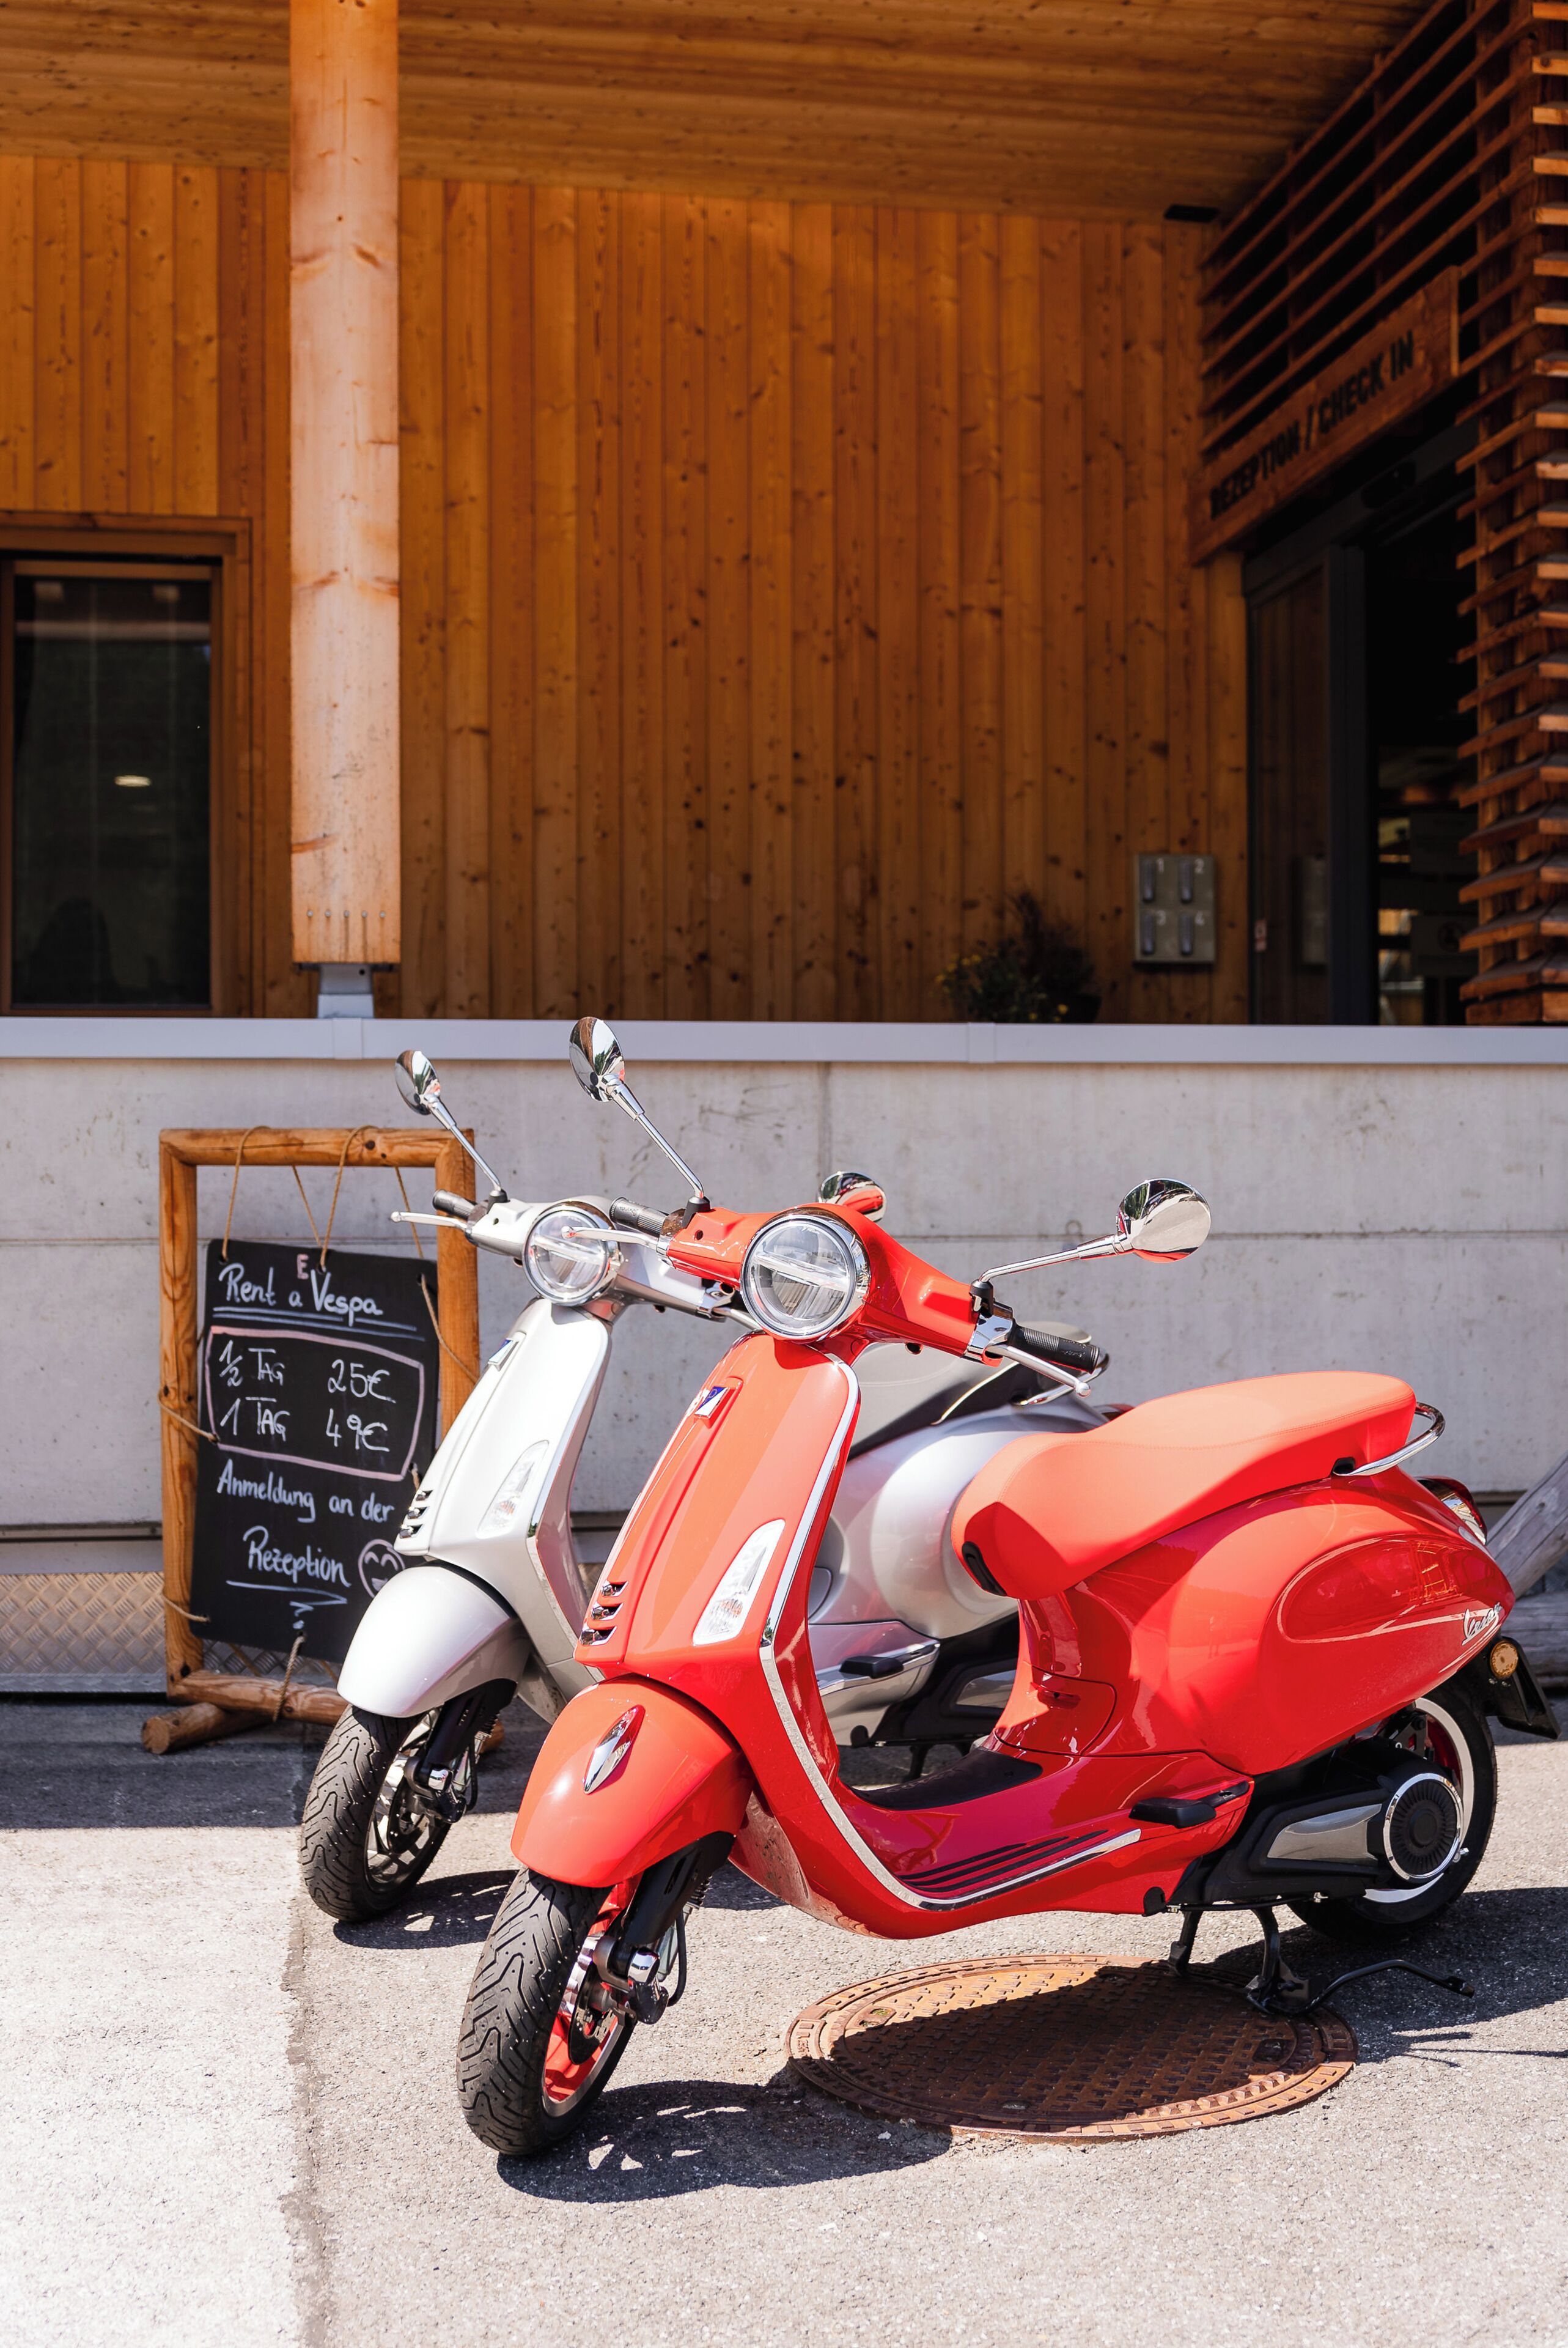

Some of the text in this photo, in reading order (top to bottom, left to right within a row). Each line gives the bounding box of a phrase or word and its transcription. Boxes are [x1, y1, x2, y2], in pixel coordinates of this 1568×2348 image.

[1304, 405, 1314, 451] /
[1317, 351, 1386, 434] CHECK
[1389, 329, 1414, 381] IN
[1194, 858, 1204, 874] 2
[218, 1263, 383, 1327] Rent a Vespa
[296, 1253, 309, 1279] E
[327, 1359, 396, 1404] 25€
[219, 1397, 390, 1452] 1 TAG 49€
[217, 1458, 395, 1523] Anmeldung an der
[243, 1525, 352, 1588] Rezeption
